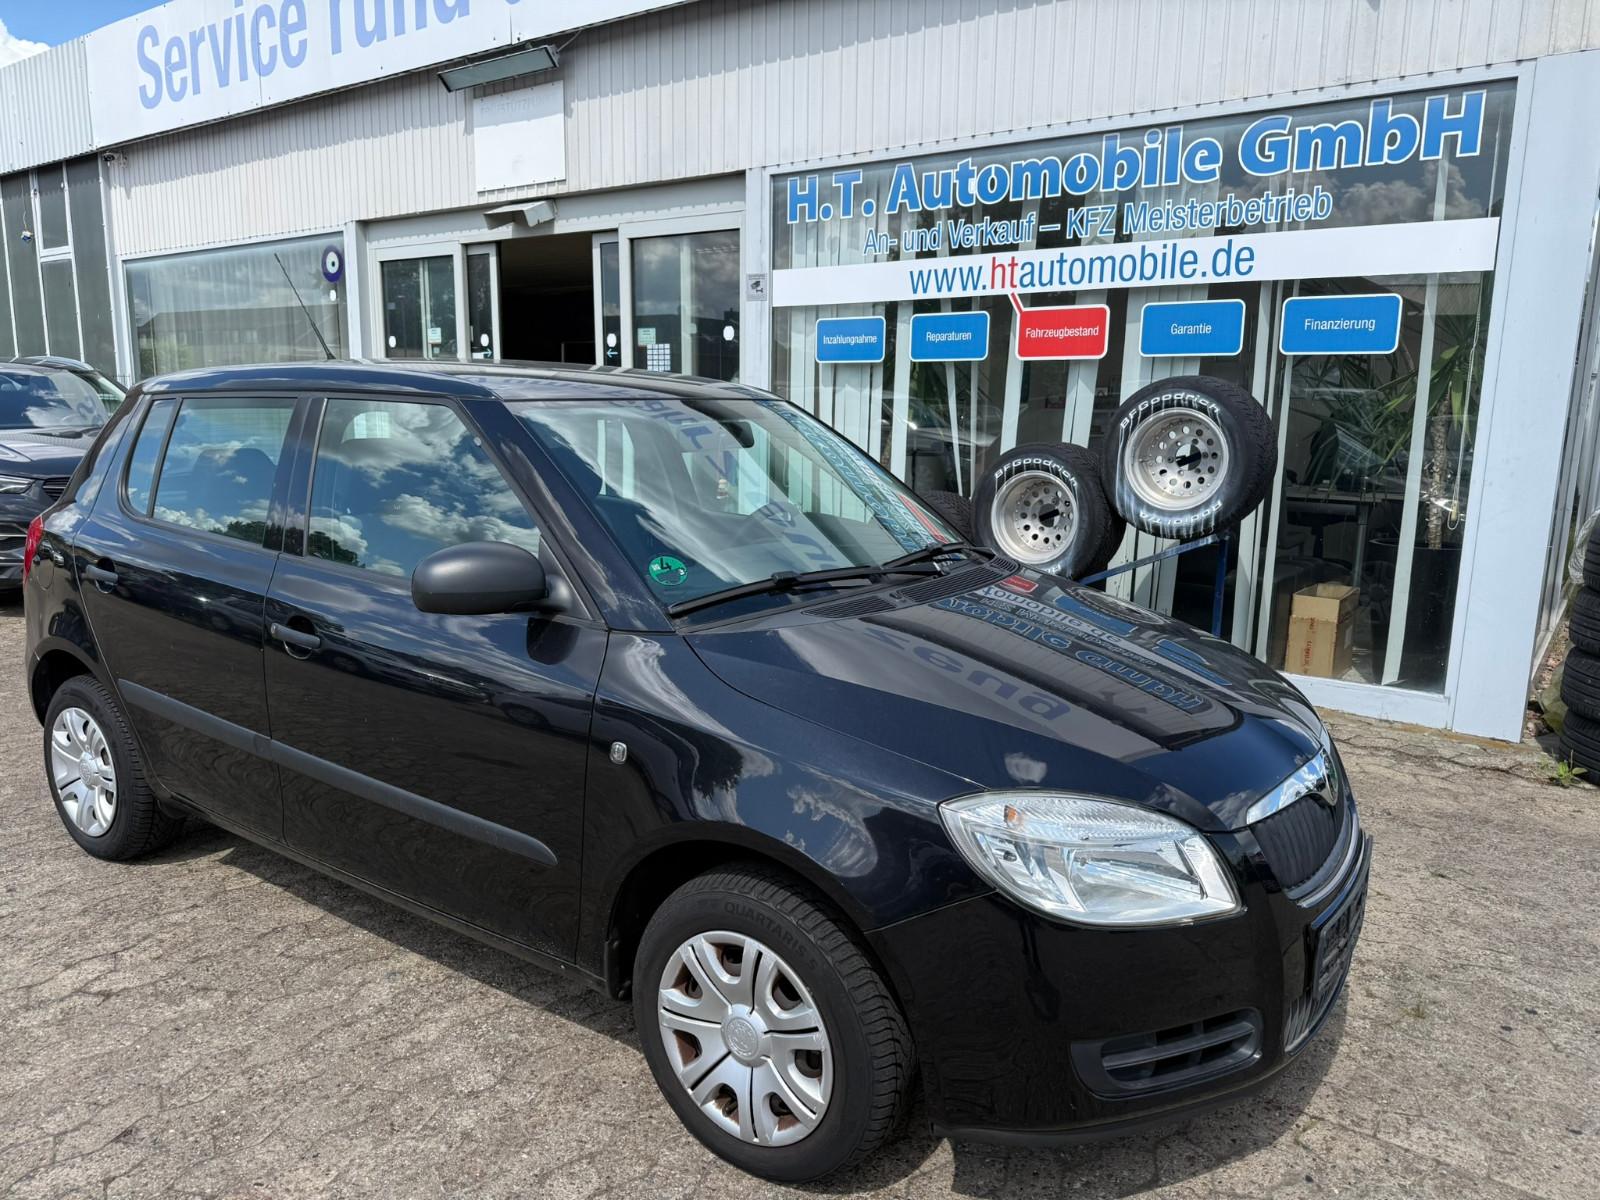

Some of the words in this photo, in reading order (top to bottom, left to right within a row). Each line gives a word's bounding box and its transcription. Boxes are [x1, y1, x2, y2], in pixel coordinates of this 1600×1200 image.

[137, 0, 308, 110] Service
[786, 168, 877, 225] H.T.
[885, 125, 1224, 215] Automobile
[1238, 88, 1488, 177] GmbH
[863, 228, 898, 256] An-
[903, 221, 943, 253] und
[947, 211, 1036, 249] Verkauf
[1066, 204, 1117, 240] KFZ
[1122, 185, 1334, 236] Meisterbetrieb
[909, 238, 1256, 295] www.htautomobile.de
[925, 331, 973, 344] Reparaturen
[1025, 325, 1100, 340] Fahrzeugbestand
[1170, 322, 1212, 336] Garantie
[1304, 317, 1377, 332] Finanzierung
[822, 333, 878, 347] Inzahlungnahme
[1119, 391, 1221, 429] BFGoodrich
[993, 457, 1079, 487] BFGoodrich
